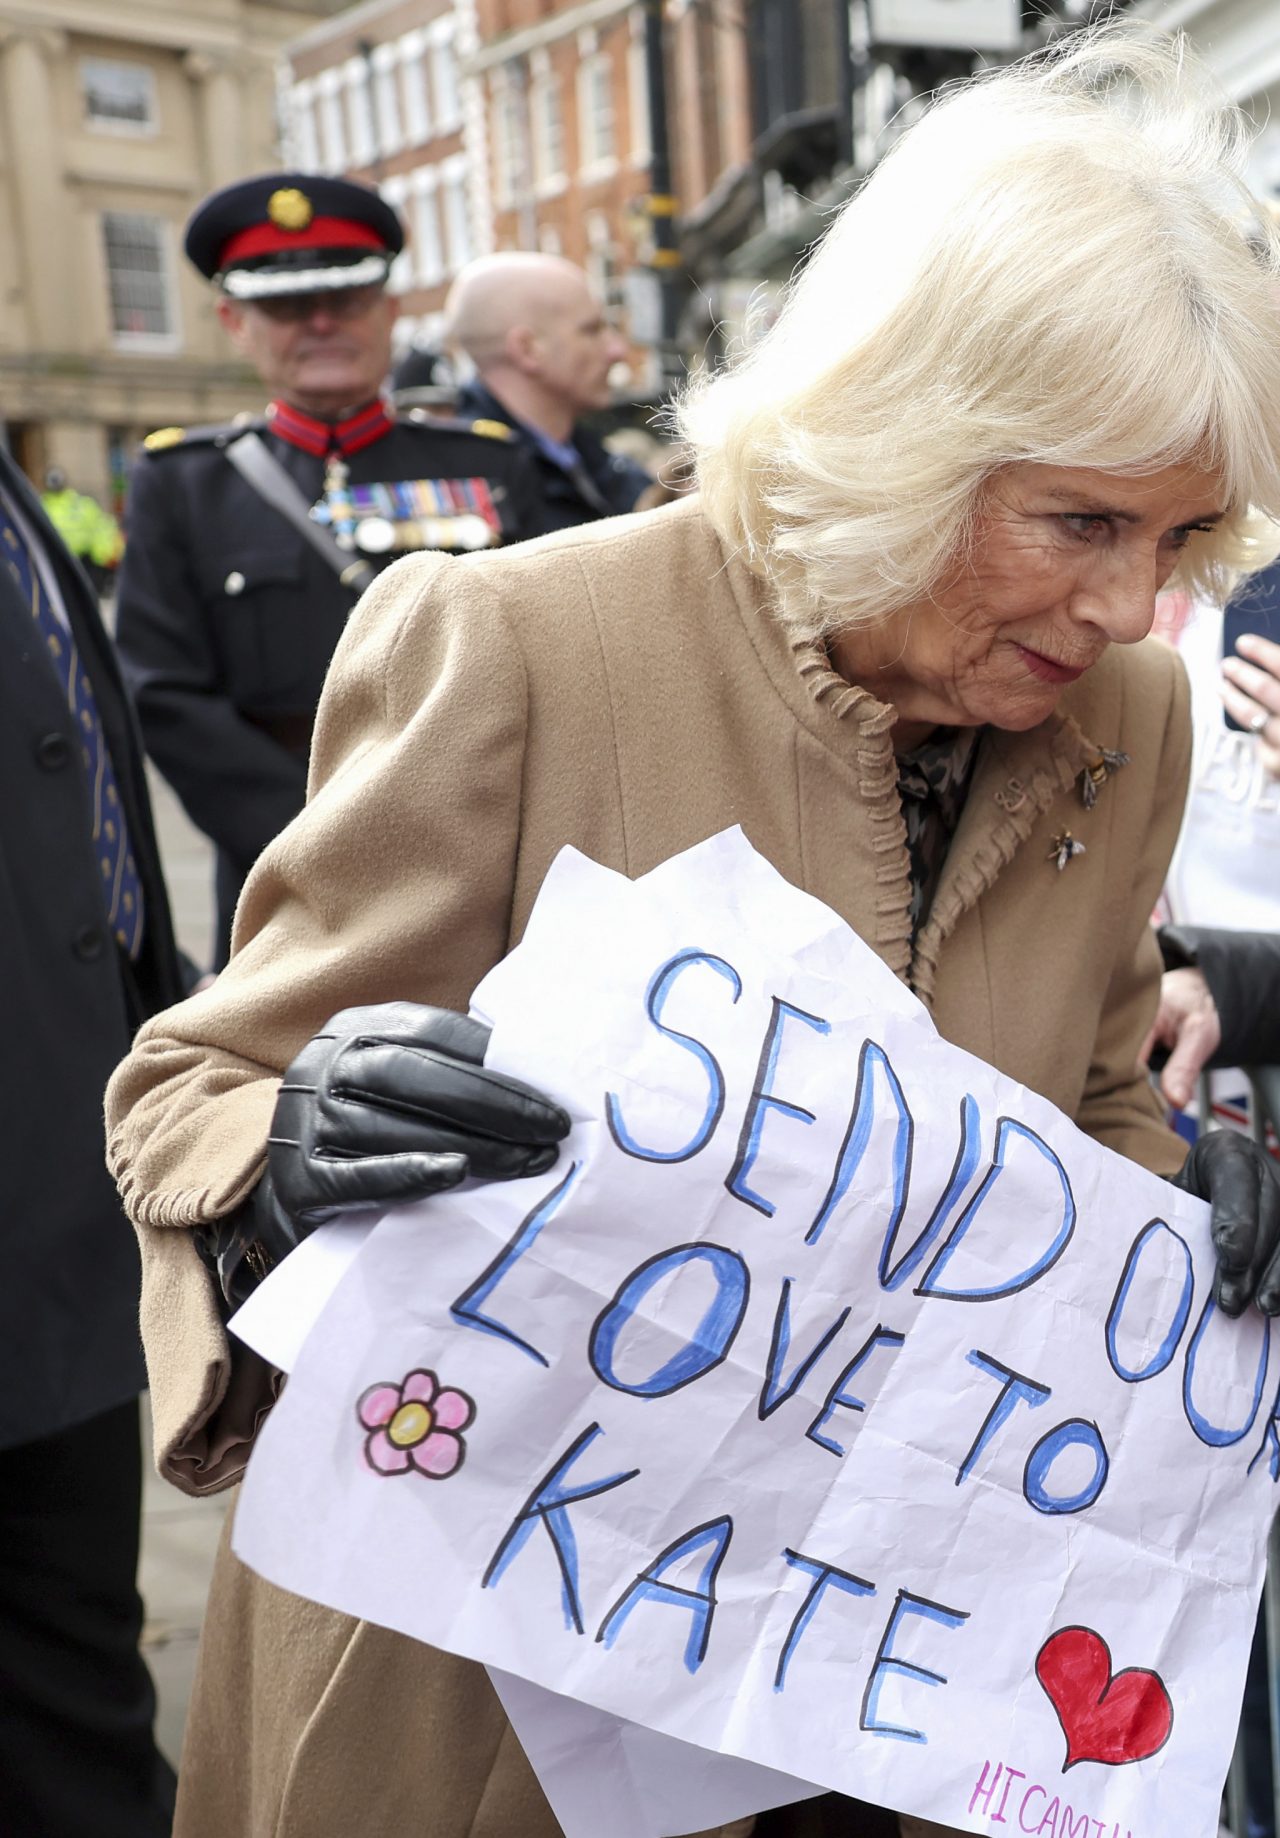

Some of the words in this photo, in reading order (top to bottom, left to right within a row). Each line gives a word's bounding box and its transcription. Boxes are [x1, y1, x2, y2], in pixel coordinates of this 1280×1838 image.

[606, 945, 1077, 1302] SEND
[450, 1160, 905, 1457] LOVE
[955, 1349, 1110, 1516] TO
[482, 1421, 971, 1745] KATE
[967, 1759, 1027, 1824] HI
[1018, 1784, 1133, 1838] CAM
